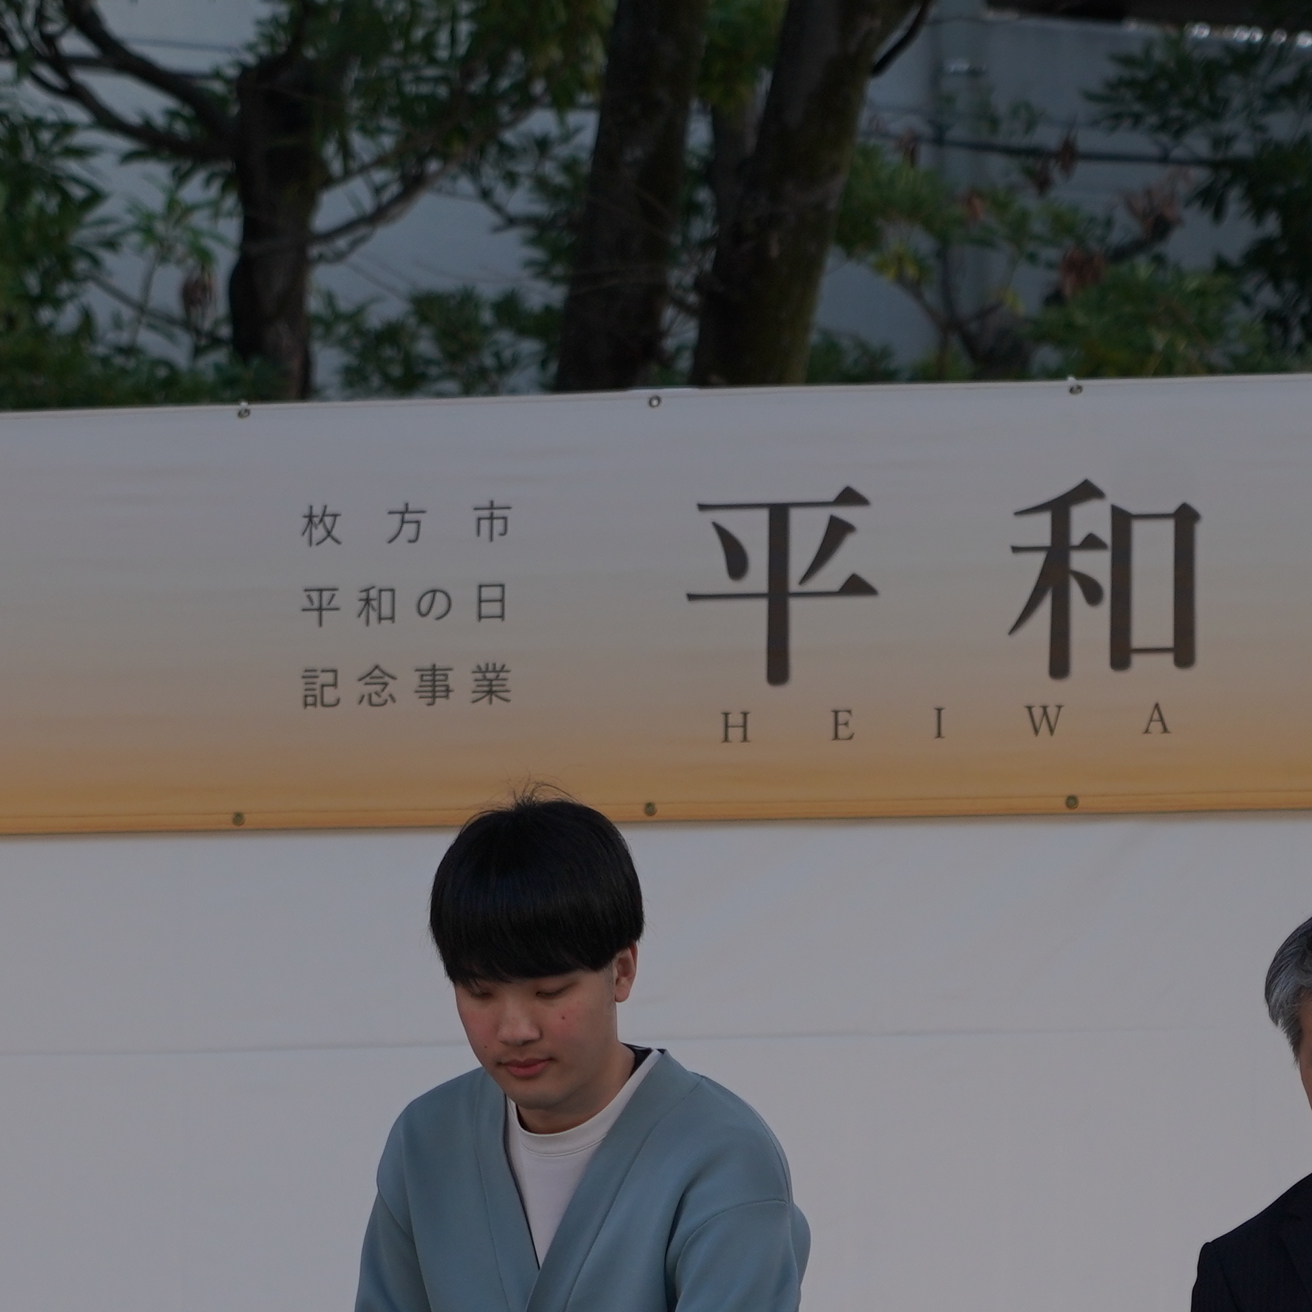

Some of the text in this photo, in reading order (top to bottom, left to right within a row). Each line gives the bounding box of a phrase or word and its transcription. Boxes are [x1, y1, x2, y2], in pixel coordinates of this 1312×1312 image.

[300, 498, 514, 549] 枚方市
[300, 581, 508, 628] 平和の日
[300, 661, 513, 711] 記念事業
[720, 701, 1173, 744] HEIWA
